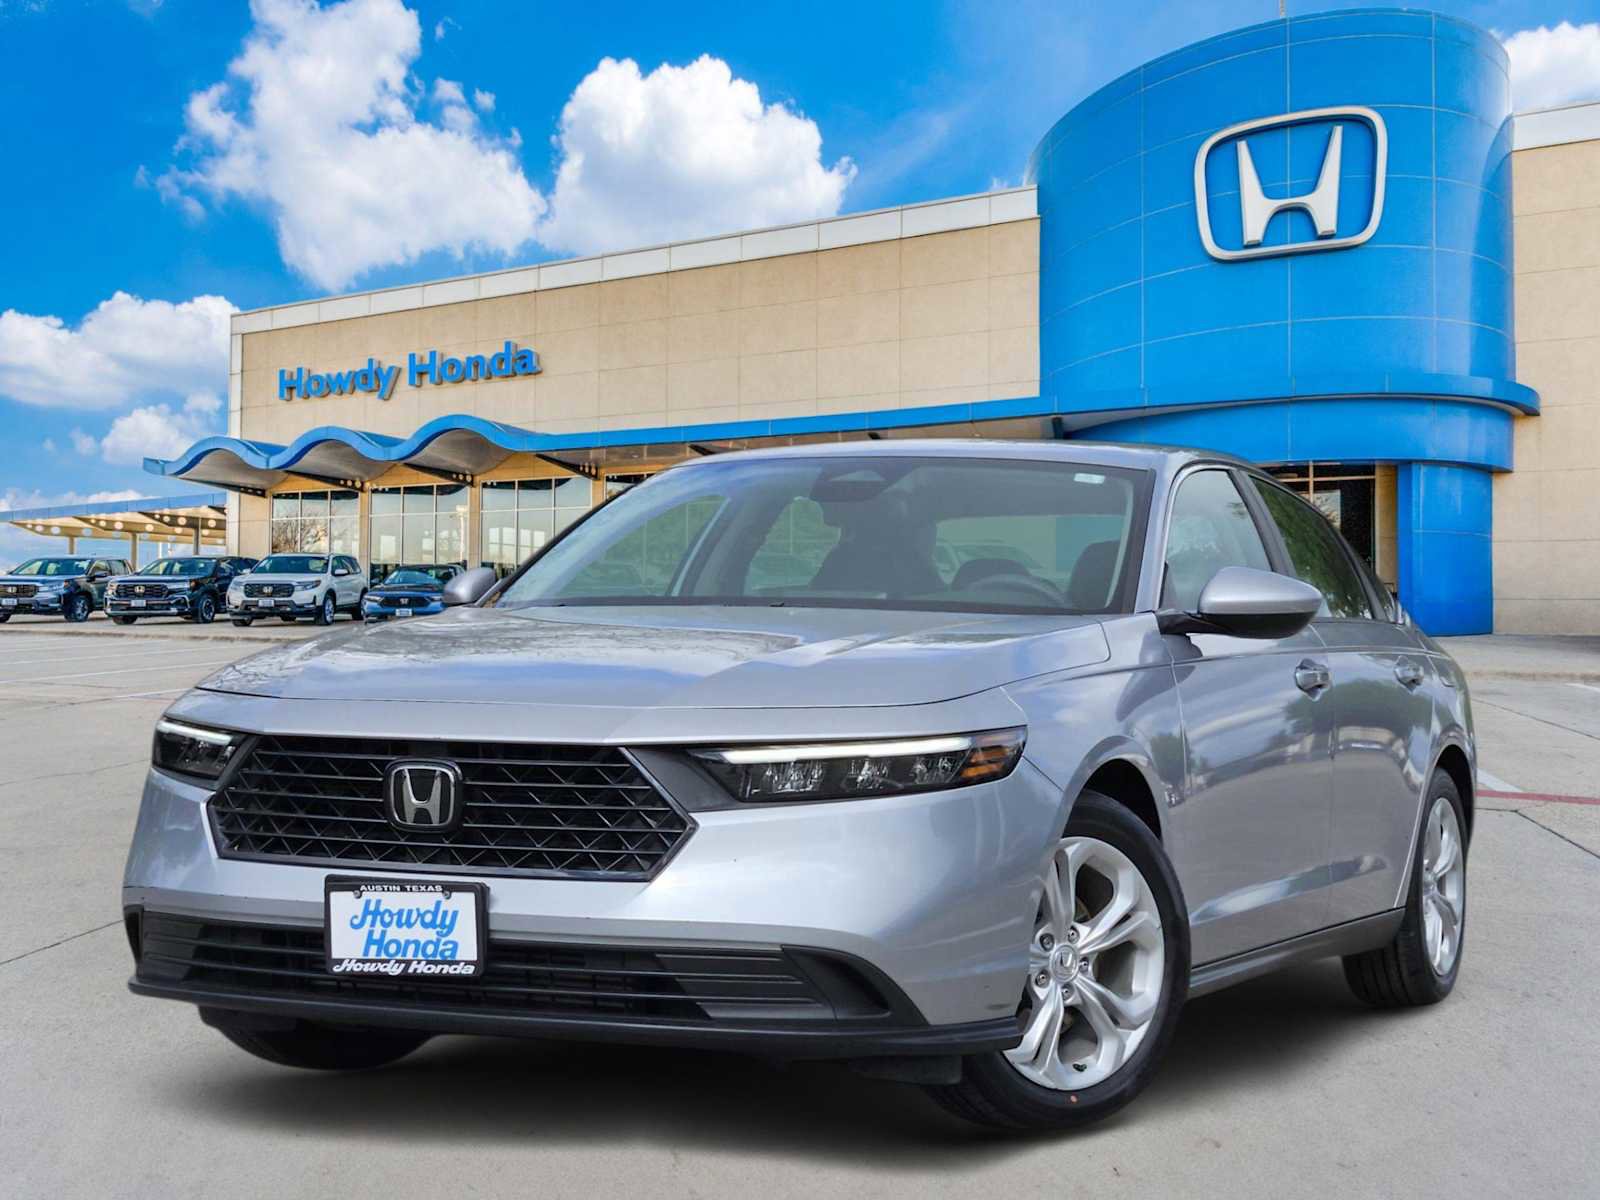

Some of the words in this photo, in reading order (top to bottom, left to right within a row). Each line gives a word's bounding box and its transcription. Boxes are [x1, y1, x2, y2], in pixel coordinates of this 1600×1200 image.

[278, 358, 401, 401] Howdy
[408, 341, 542, 387] Honda
[360, 884, 400, 892] AUSTIN
[350, 898, 459, 937] Howdy
[362, 929, 459, 960] Honda
[332, 959, 405, 976] Howdy
[408, 960, 475, 975] Honda
